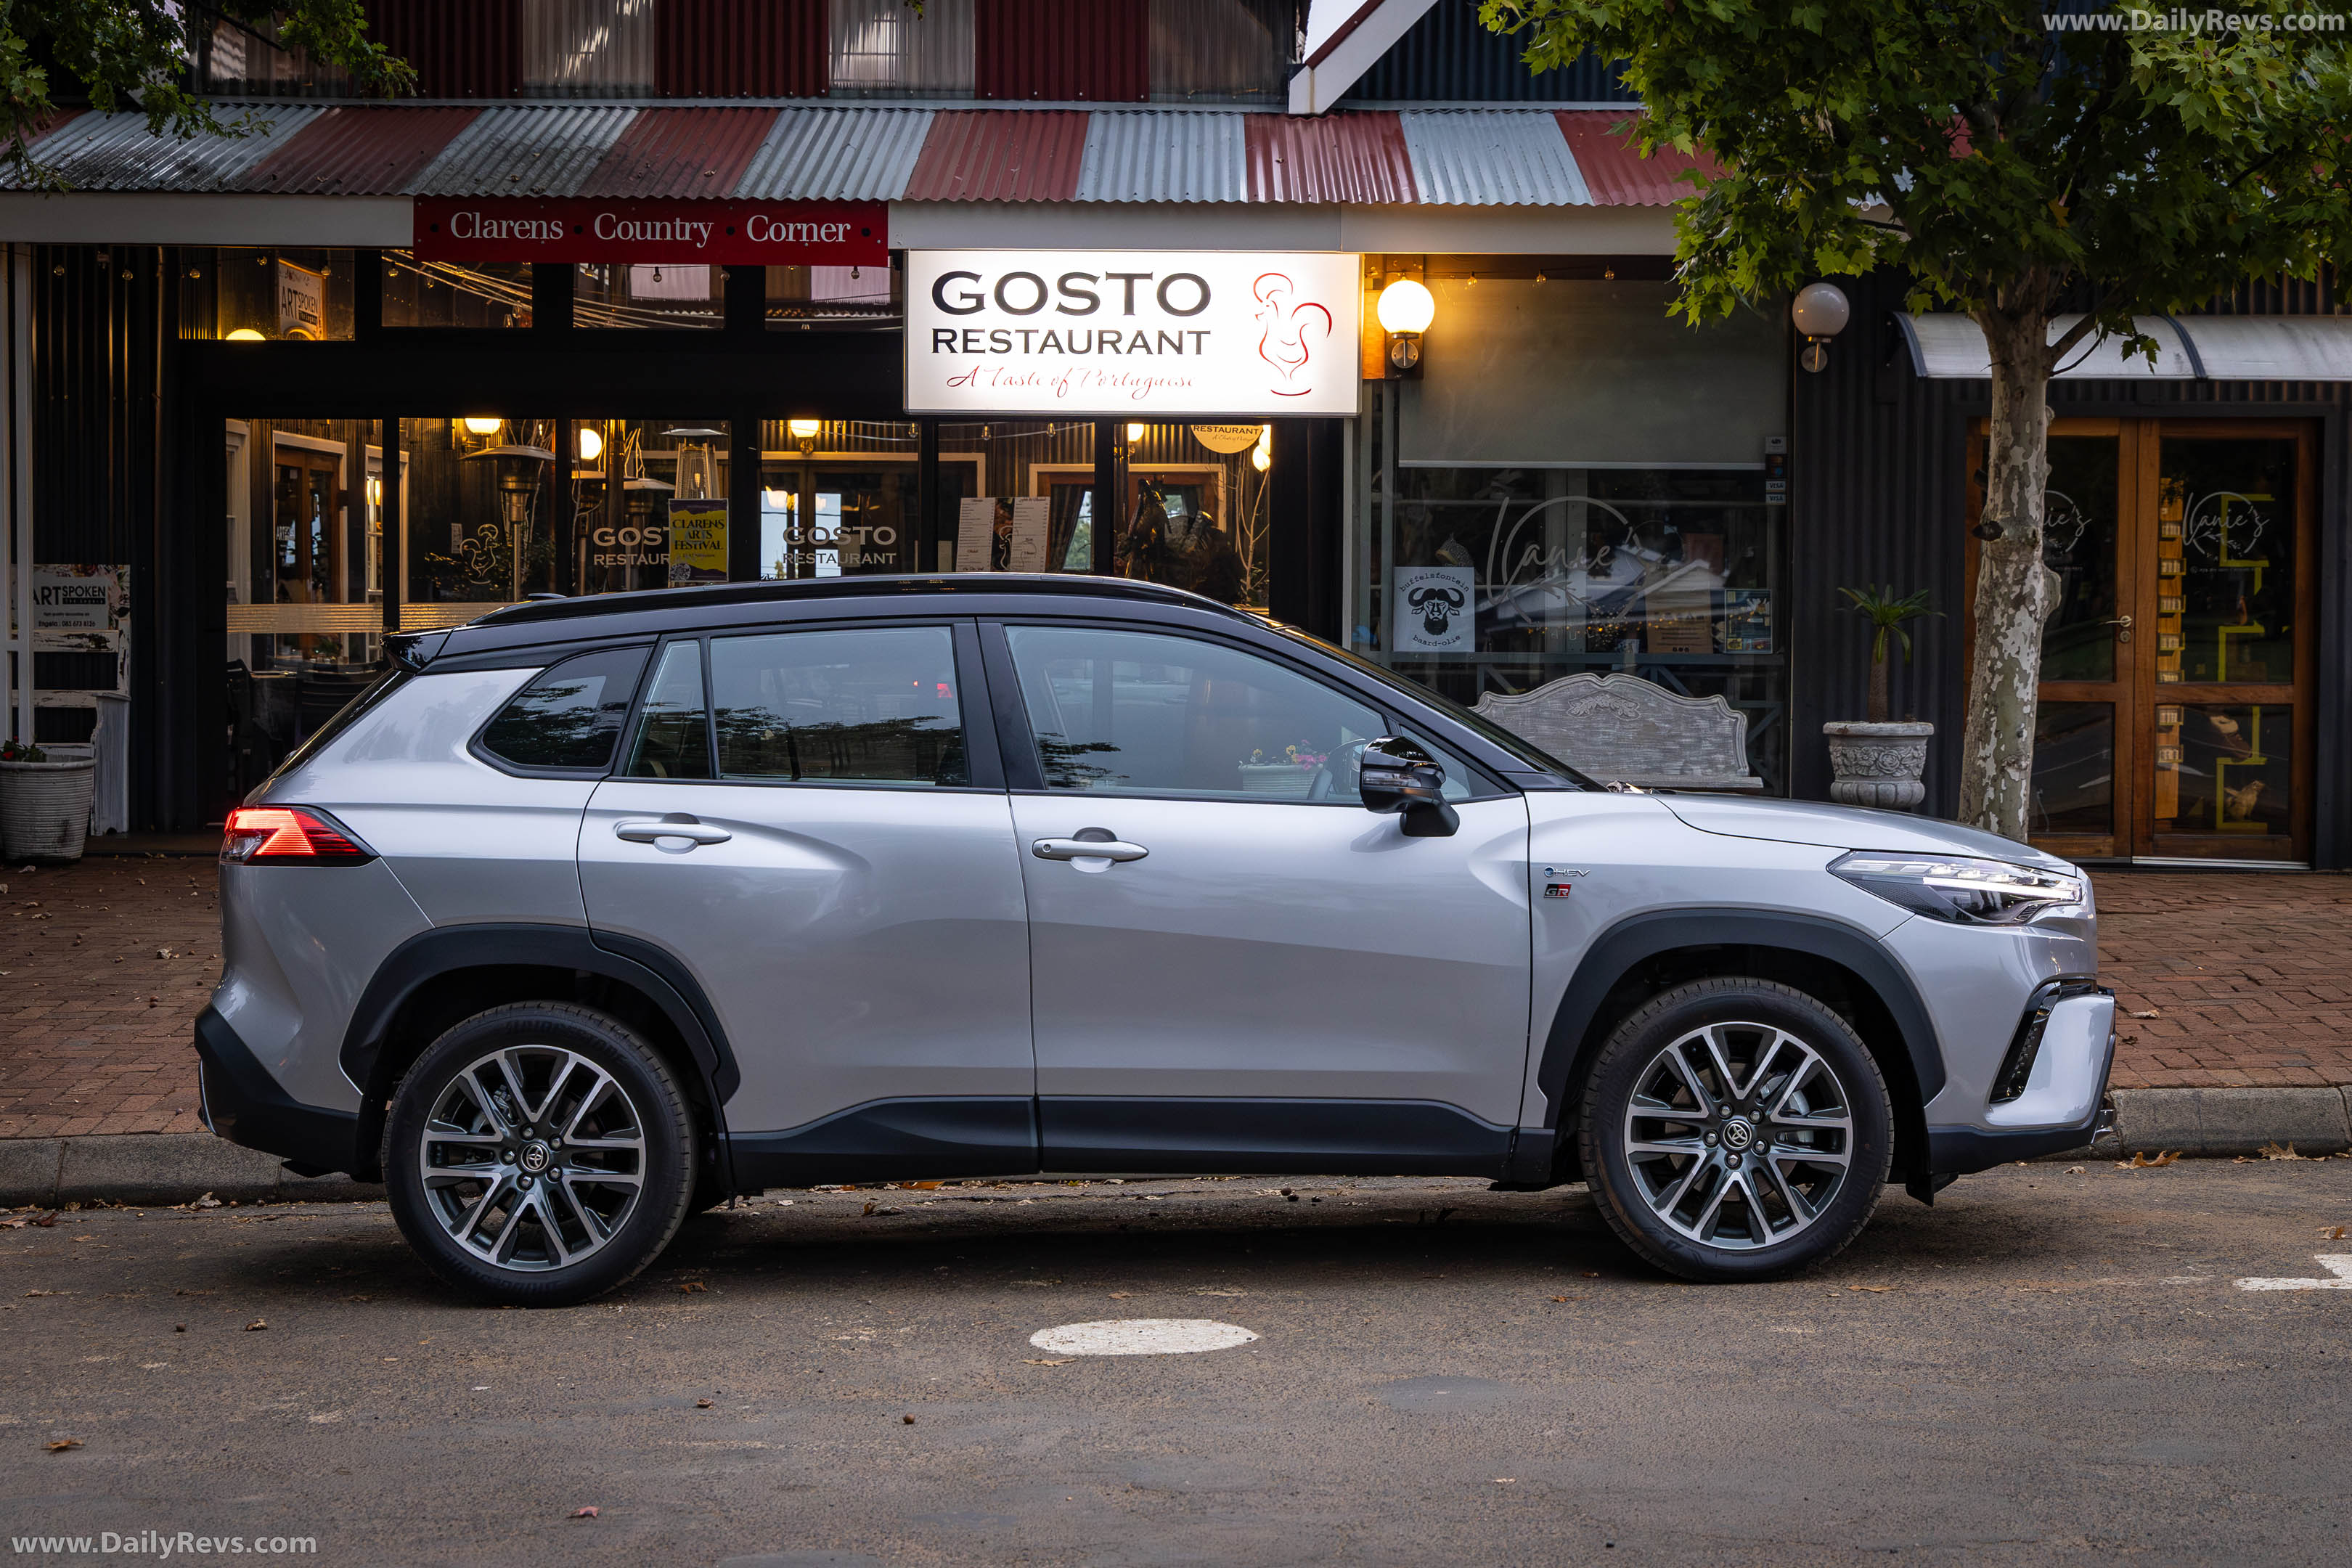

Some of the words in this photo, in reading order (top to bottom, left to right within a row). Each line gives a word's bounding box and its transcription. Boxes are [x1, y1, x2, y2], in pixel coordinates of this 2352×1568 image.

[450, 211, 564, 240] Clarens
[594, 213, 715, 248] Country
[746, 215, 852, 242] Corner
[931, 271, 1212, 317] GOSTO
[931, 327, 1212, 356] RESTAURANT
[946, 365, 980, 388] A
[983, 367, 1041, 387] Taste
[1050, 367, 1073, 398] of
[1076, 367, 1193, 400] Portuguese
[1193, 425, 1259, 436] RESTAURANT
[672, 518, 724, 529] CLARENS
[687, 530, 713, 540] ARTS
[783, 526, 897, 546] GOSTO
[674, 540, 721, 550] FESTIVAL
[783, 552, 897, 565] RESTAURANT
[1399, 572, 1470, 592] buffelsfontein
[62, 585, 106, 597] SPOKEN
[1412, 634, 1461, 647] baard-olie
